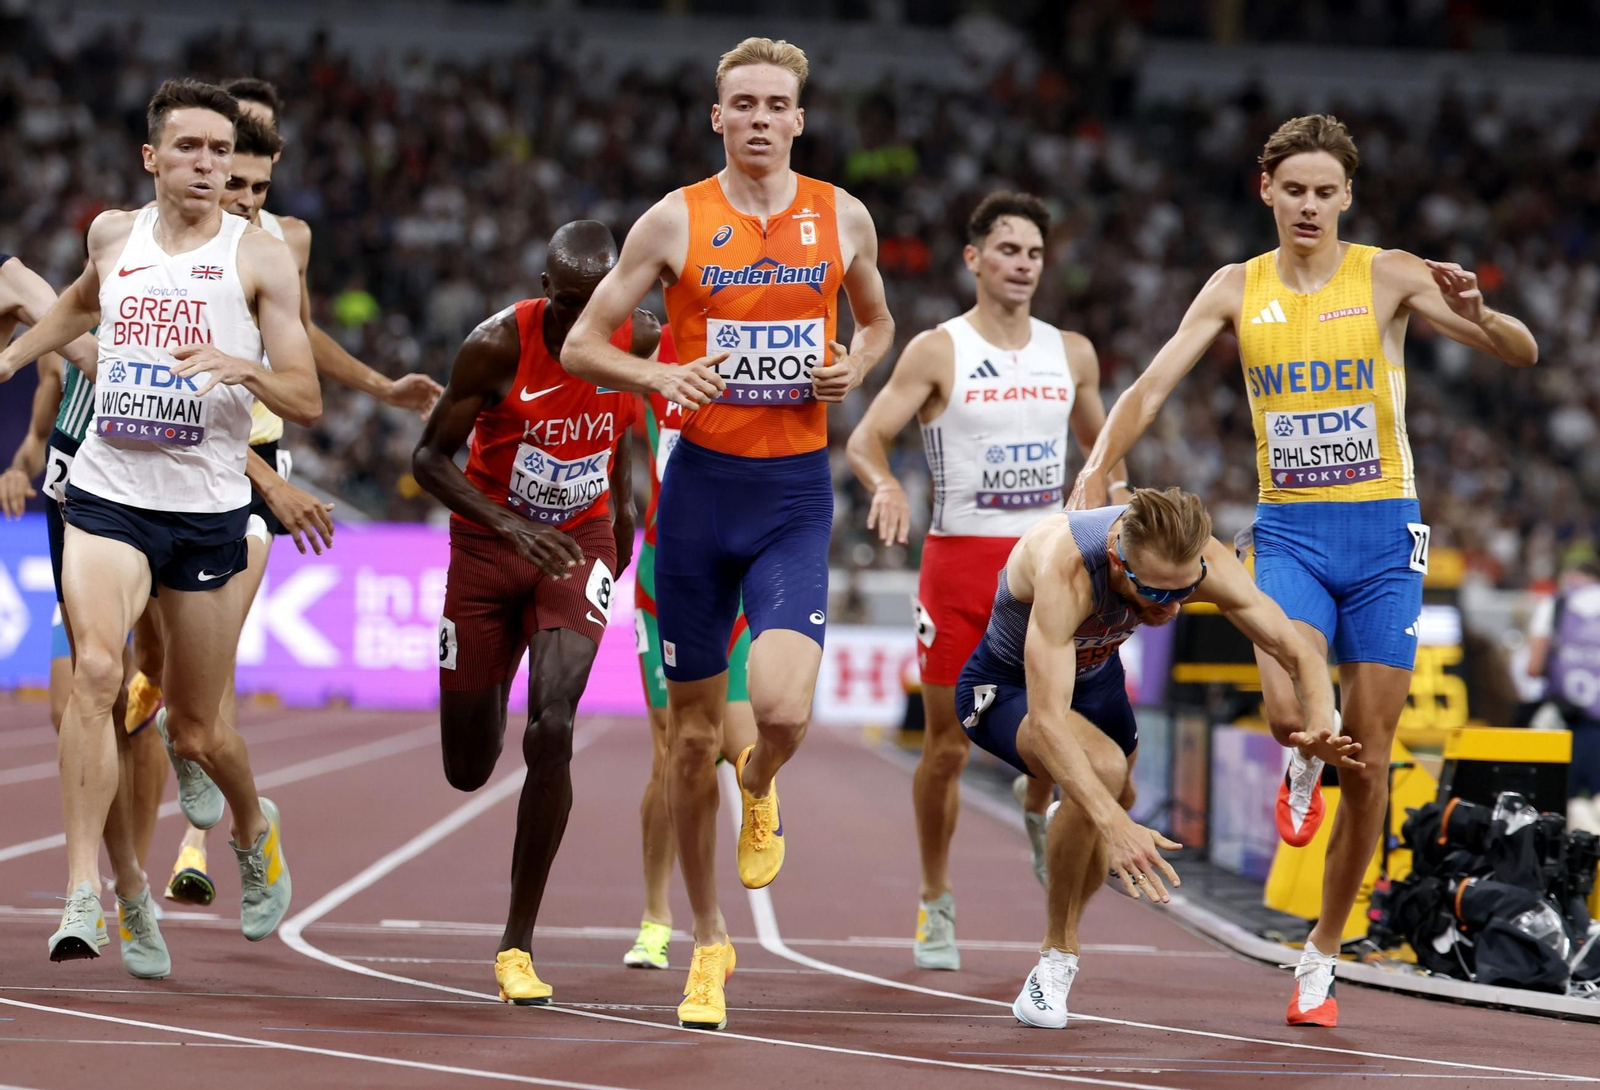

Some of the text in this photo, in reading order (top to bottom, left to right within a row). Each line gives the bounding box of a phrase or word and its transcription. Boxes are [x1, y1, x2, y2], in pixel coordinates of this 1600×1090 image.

[701, 261, 828, 286] Nederland
[119, 296, 207, 325] GREAT
[1319, 306, 1369, 322] BAUHAUS
[114, 322, 212, 348] BRITAIN
[740, 323, 817, 349] TDK
[128, 361, 199, 392] TDK
[714, 354, 818, 381] LAROS
[1248, 358, 1374, 397] SWEDEN
[102, 392, 203, 424] WIGHTMAN
[1292, 406, 1369, 436] TDK
[522, 412, 614, 446] KENYA
[1006, 439, 1058, 462] TDK
[1273, 437, 1374, 467] PIHLSTRÖM
[546, 454, 604, 482] TDK
[982, 464, 1060, 489] MORNET
[516, 471, 525, 494] T.
[527, 477, 604, 506] CHERUIYOT
[596, 577, 611, 610] 8
